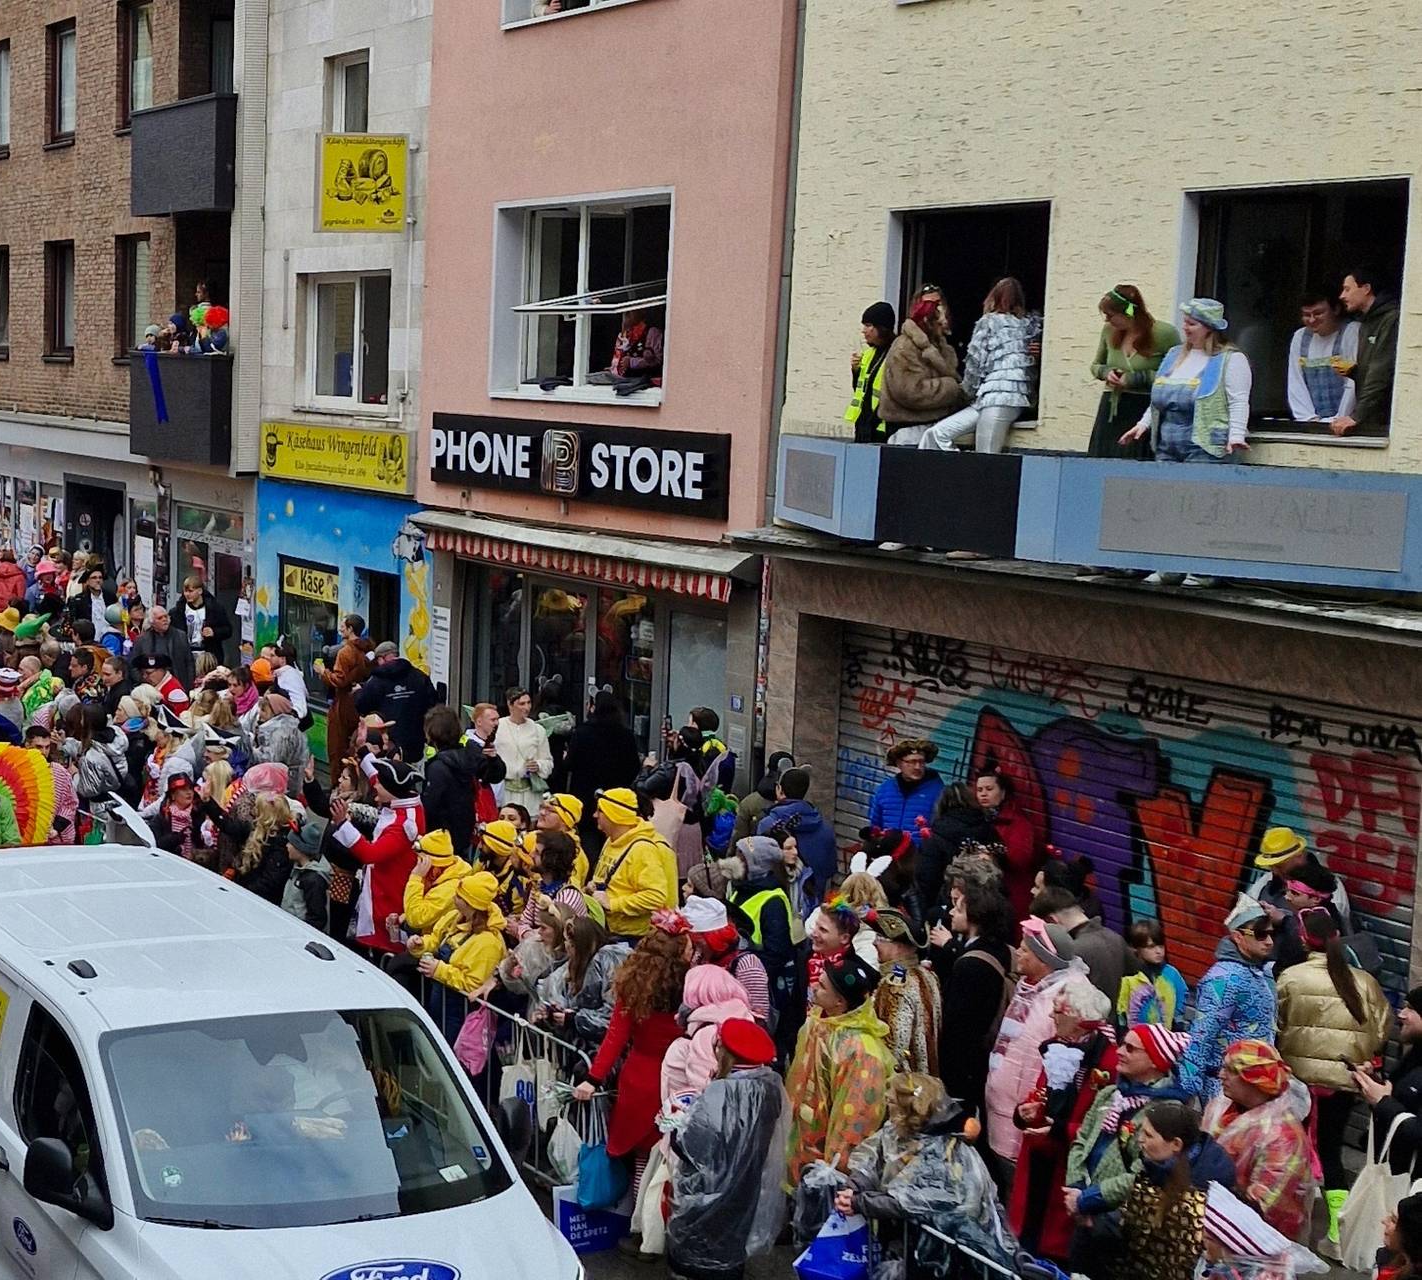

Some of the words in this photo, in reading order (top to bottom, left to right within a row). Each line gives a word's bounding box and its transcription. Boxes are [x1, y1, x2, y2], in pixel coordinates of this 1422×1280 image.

[286, 429, 326, 452] Käsehaus
[327, 432, 379, 462] Wingenfeld
[430, 428, 532, 479] PHONE
[590, 442, 705, 501] STORE
[300, 568, 326, 596] Käse
